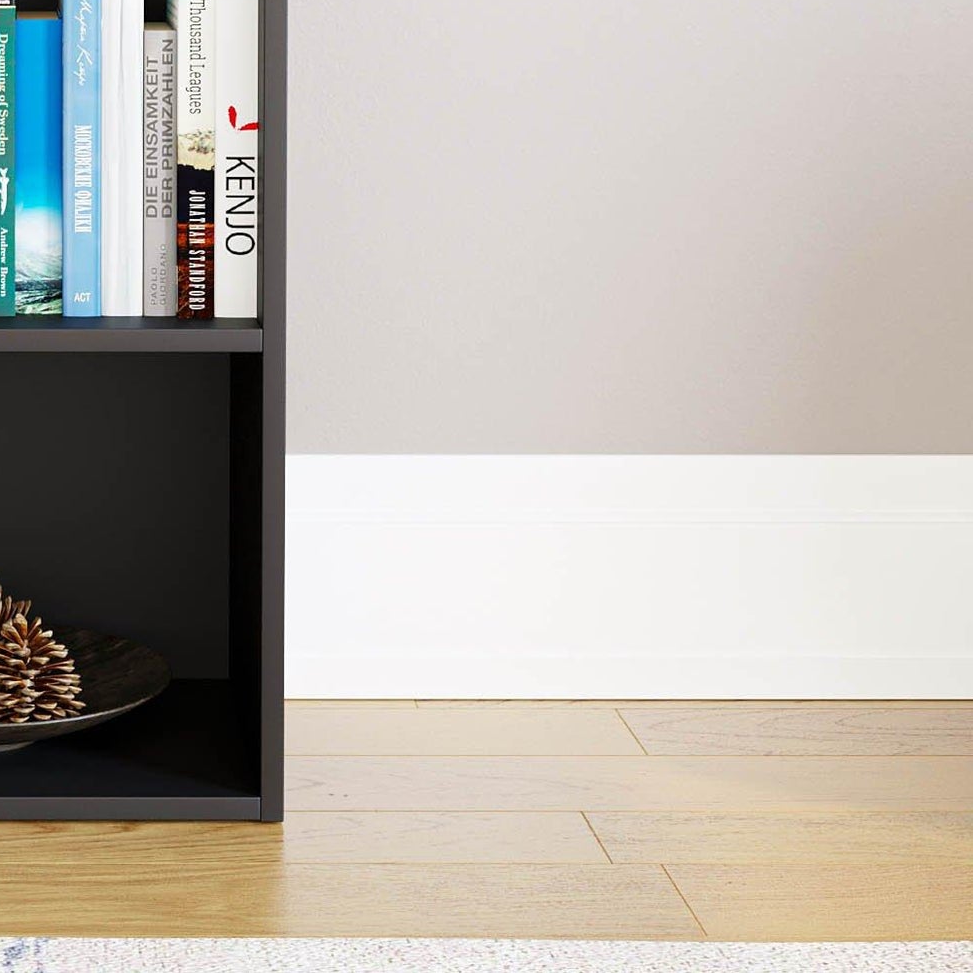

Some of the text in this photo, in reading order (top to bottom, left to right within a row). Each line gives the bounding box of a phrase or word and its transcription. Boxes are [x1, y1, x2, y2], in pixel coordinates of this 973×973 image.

[0, 94, 9, 108] of
[185, 0, 206, 115] Thousand Leagues
[0, 109, 9, 156] Sweden
[145, 56, 158, 218] DIE EINSAMKEIT
[161, 39, 173, 218] DER PRIMZAHLEN
[188, 189, 206, 311] JONATHAN STANDFORD
[225, 156, 256, 256] KENJO
[0, 226, 9, 298] Andrew Brown
[150, 267, 158, 306] PAOLO
